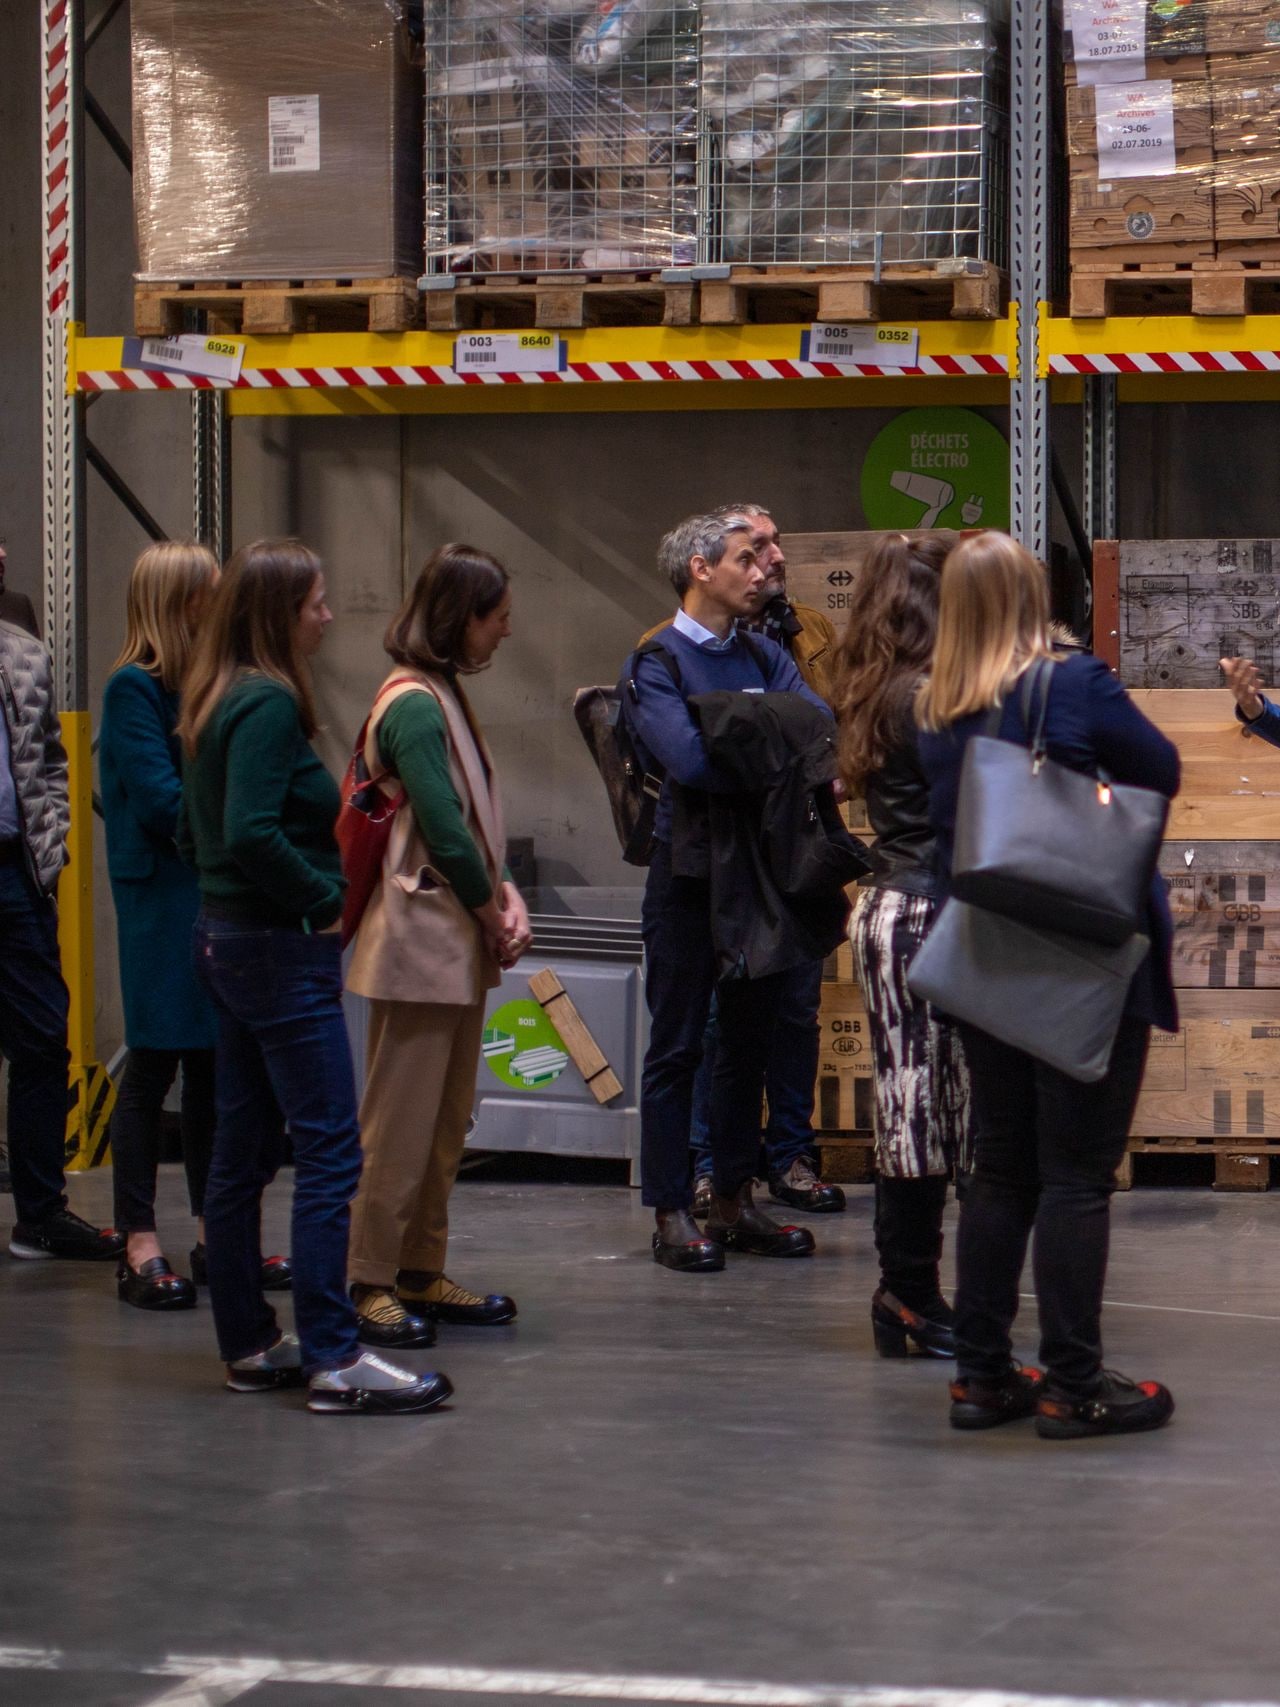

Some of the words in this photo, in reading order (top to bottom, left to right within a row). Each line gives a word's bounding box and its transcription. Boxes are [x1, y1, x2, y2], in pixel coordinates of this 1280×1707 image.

[1088, 44, 1138, 57] 18.07.2019
[1126, 93, 1144, 102] WA
[1116, 110, 1156, 118] Archives
[1111, 138, 1162, 149] 02.07.2019
[824, 327, 849, 338] 005
[878, 329, 909, 341] 0352
[207, 340, 236, 355] 6928
[469, 336, 493, 347] 003
[521, 335, 551, 346] 8640
[910, 430, 969, 449] DÉCHETS
[911, 450, 970, 468] ÉLECTRO
[1232, 603, 1261, 619] SBB
[838, 1039, 855, 1052] EUR
